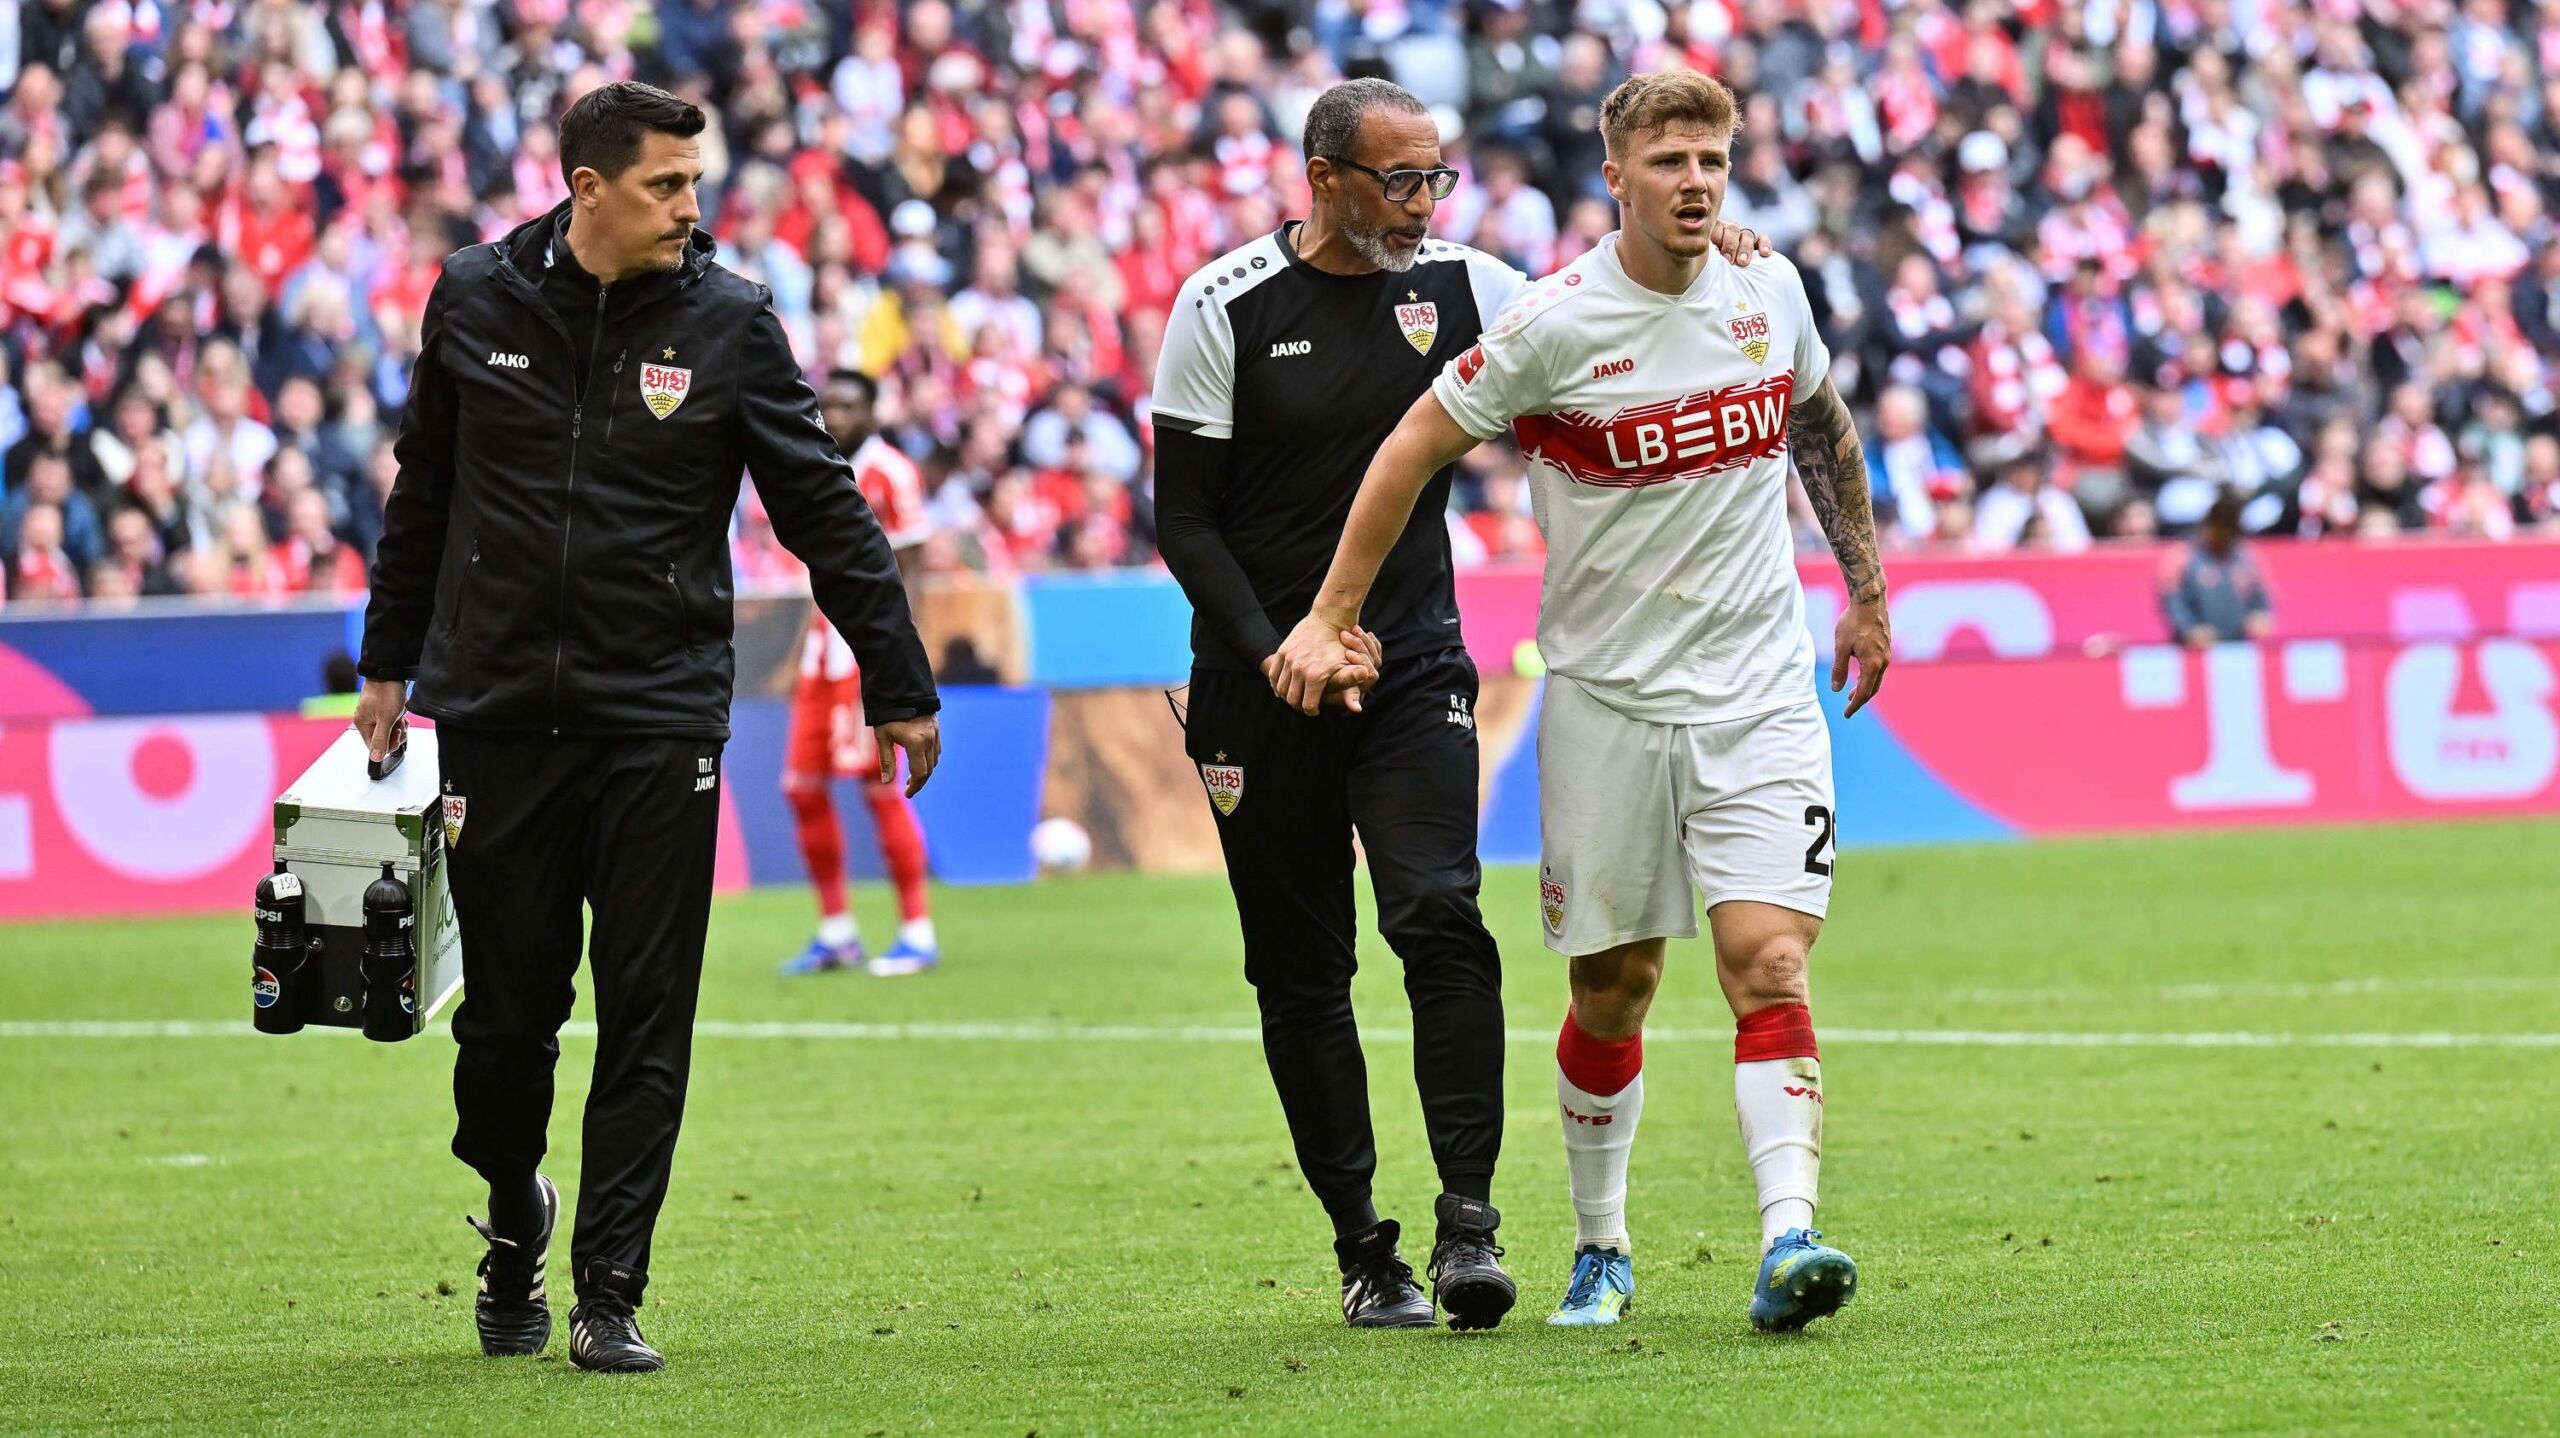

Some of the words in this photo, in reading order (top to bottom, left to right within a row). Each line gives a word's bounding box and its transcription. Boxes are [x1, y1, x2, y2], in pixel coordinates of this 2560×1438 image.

[1270, 340, 1312, 358] JAKO
[487, 351, 530, 369] JAKO
[1592, 358, 1634, 379] JAKO
[1446, 710, 1474, 730] JAKO
[694, 774, 716, 792] JAKO
[1804, 805, 1836, 881] 2
[255, 906, 282, 923] EPSI
[255, 982, 277, 994] EPSI
